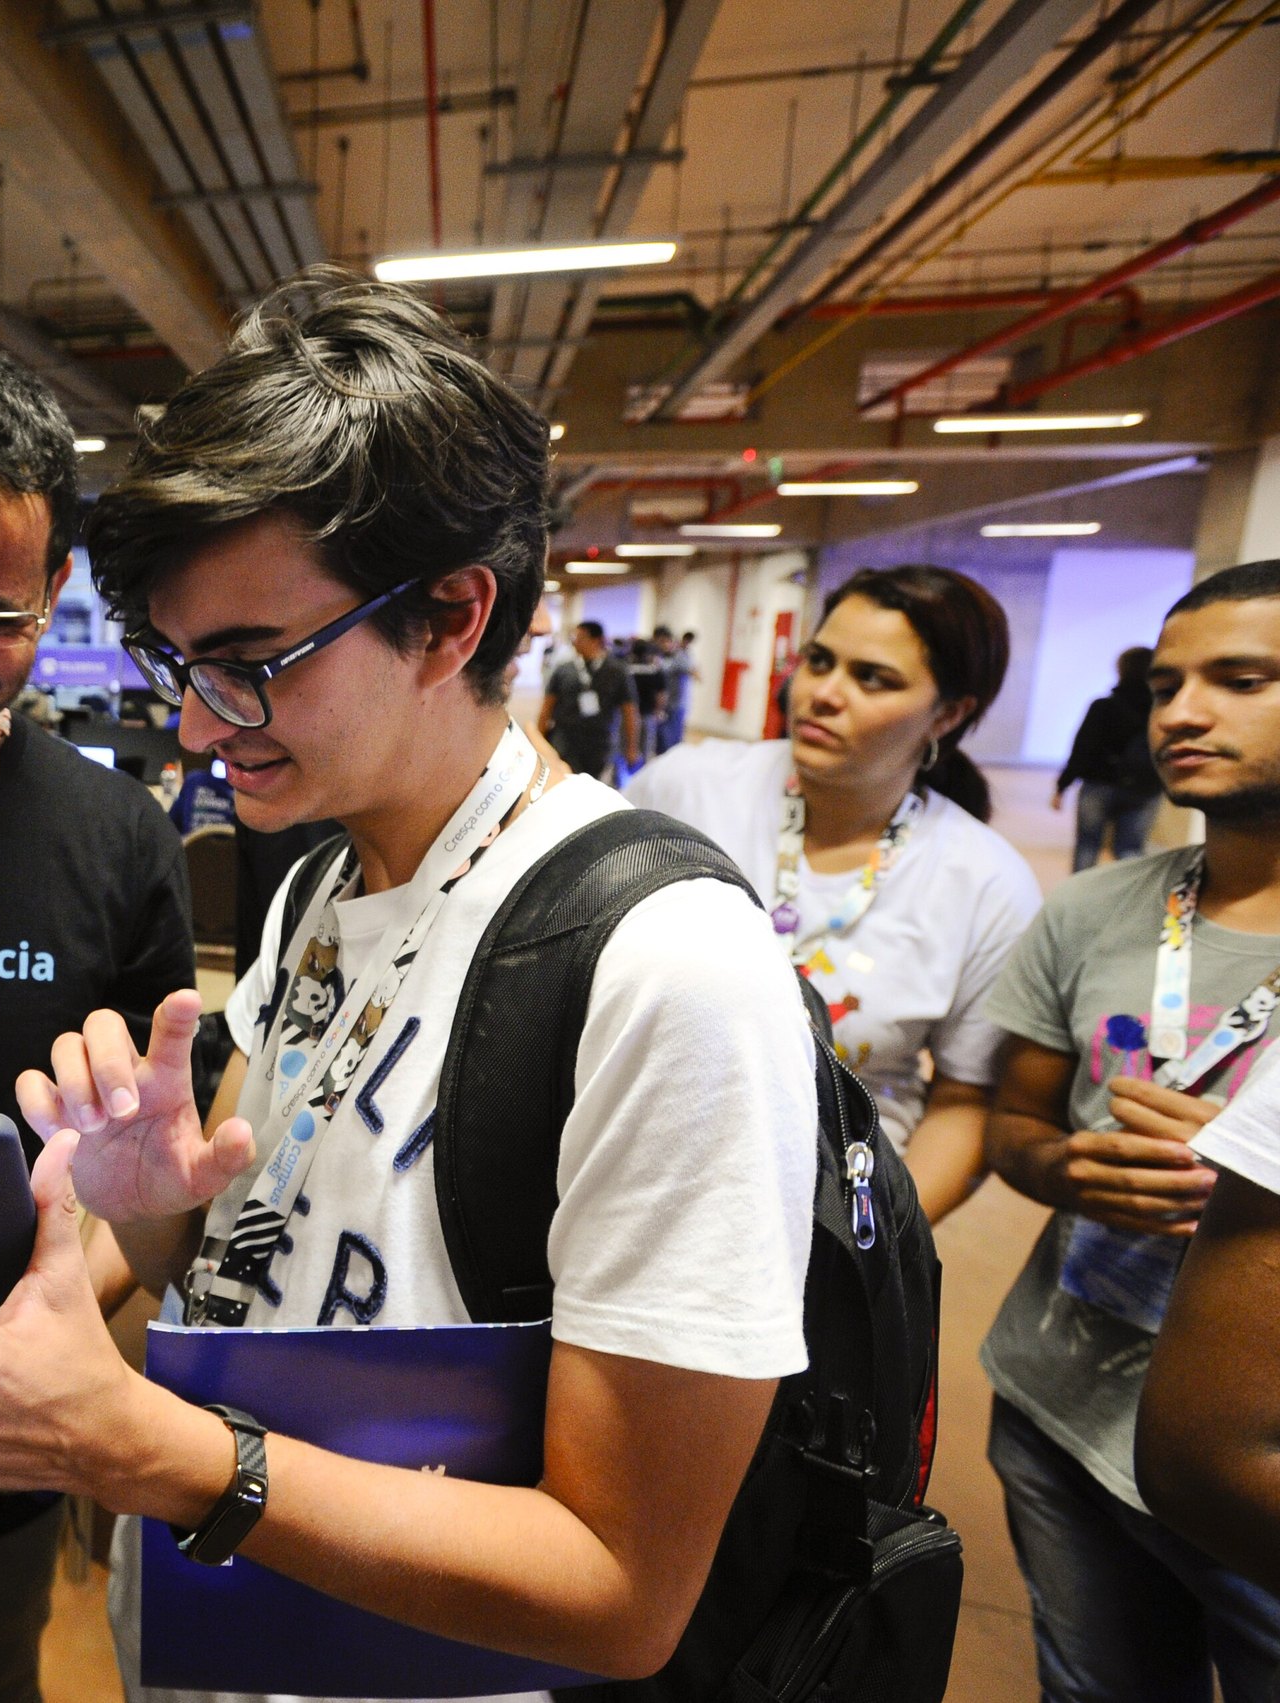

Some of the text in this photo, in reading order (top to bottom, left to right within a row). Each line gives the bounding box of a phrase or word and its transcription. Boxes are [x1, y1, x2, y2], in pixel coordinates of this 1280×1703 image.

[444, 815, 478, 853] Cresça
[475, 791, 497, 817] com
[494, 783, 503, 793] o
[281, 1083, 307, 1118] Cresça
[306, 1058, 321, 1083] com
[325, 1010, 350, 1049] Google
[266, 1136, 291, 1179] party
[270, 1144, 302, 1207] campus
